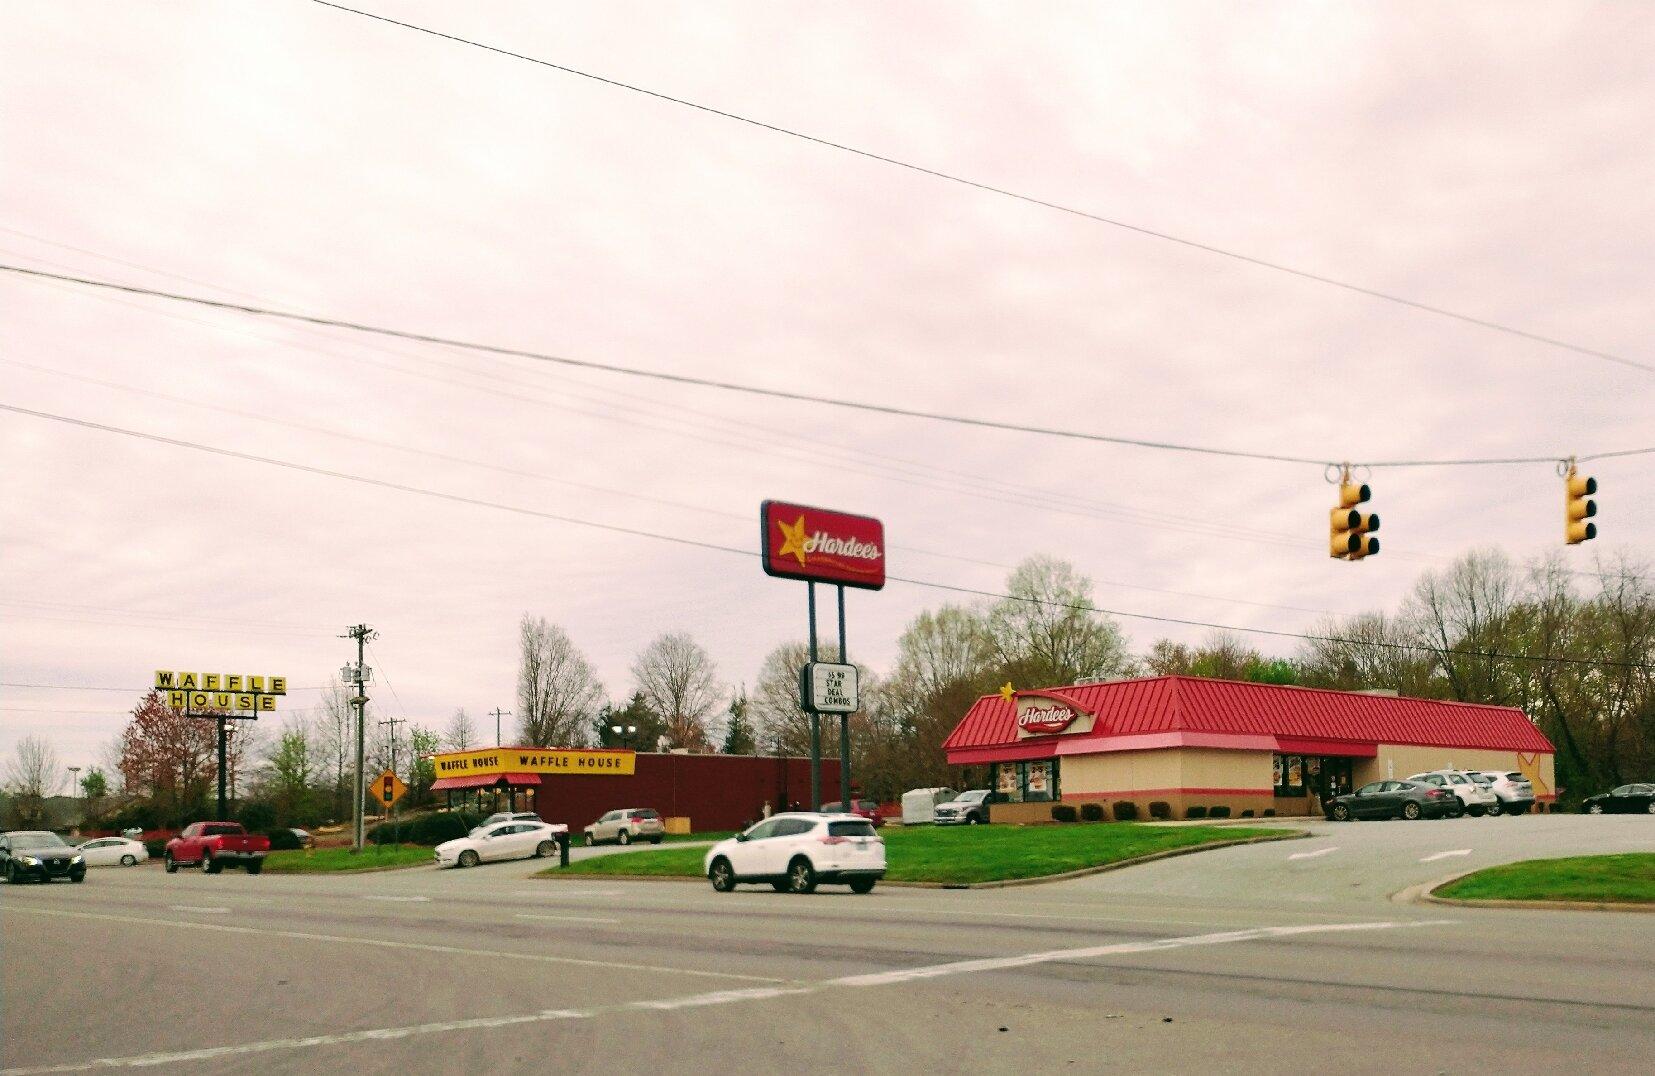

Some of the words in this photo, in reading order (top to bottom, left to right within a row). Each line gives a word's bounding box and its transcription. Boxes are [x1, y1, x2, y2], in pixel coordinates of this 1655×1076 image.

[159, 672, 283, 691] WAFFLE
[826, 680, 842, 688] STAR
[827, 688, 843, 696] DEAL
[172, 692, 274, 709] HOUSE
[824, 697, 851, 705] COMBOS
[440, 759, 468, 771] WAFFLE
[472, 756, 499, 768] HOUSE
[519, 756, 569, 767] WAFFLE
[578, 758, 622, 768] HOUSE
